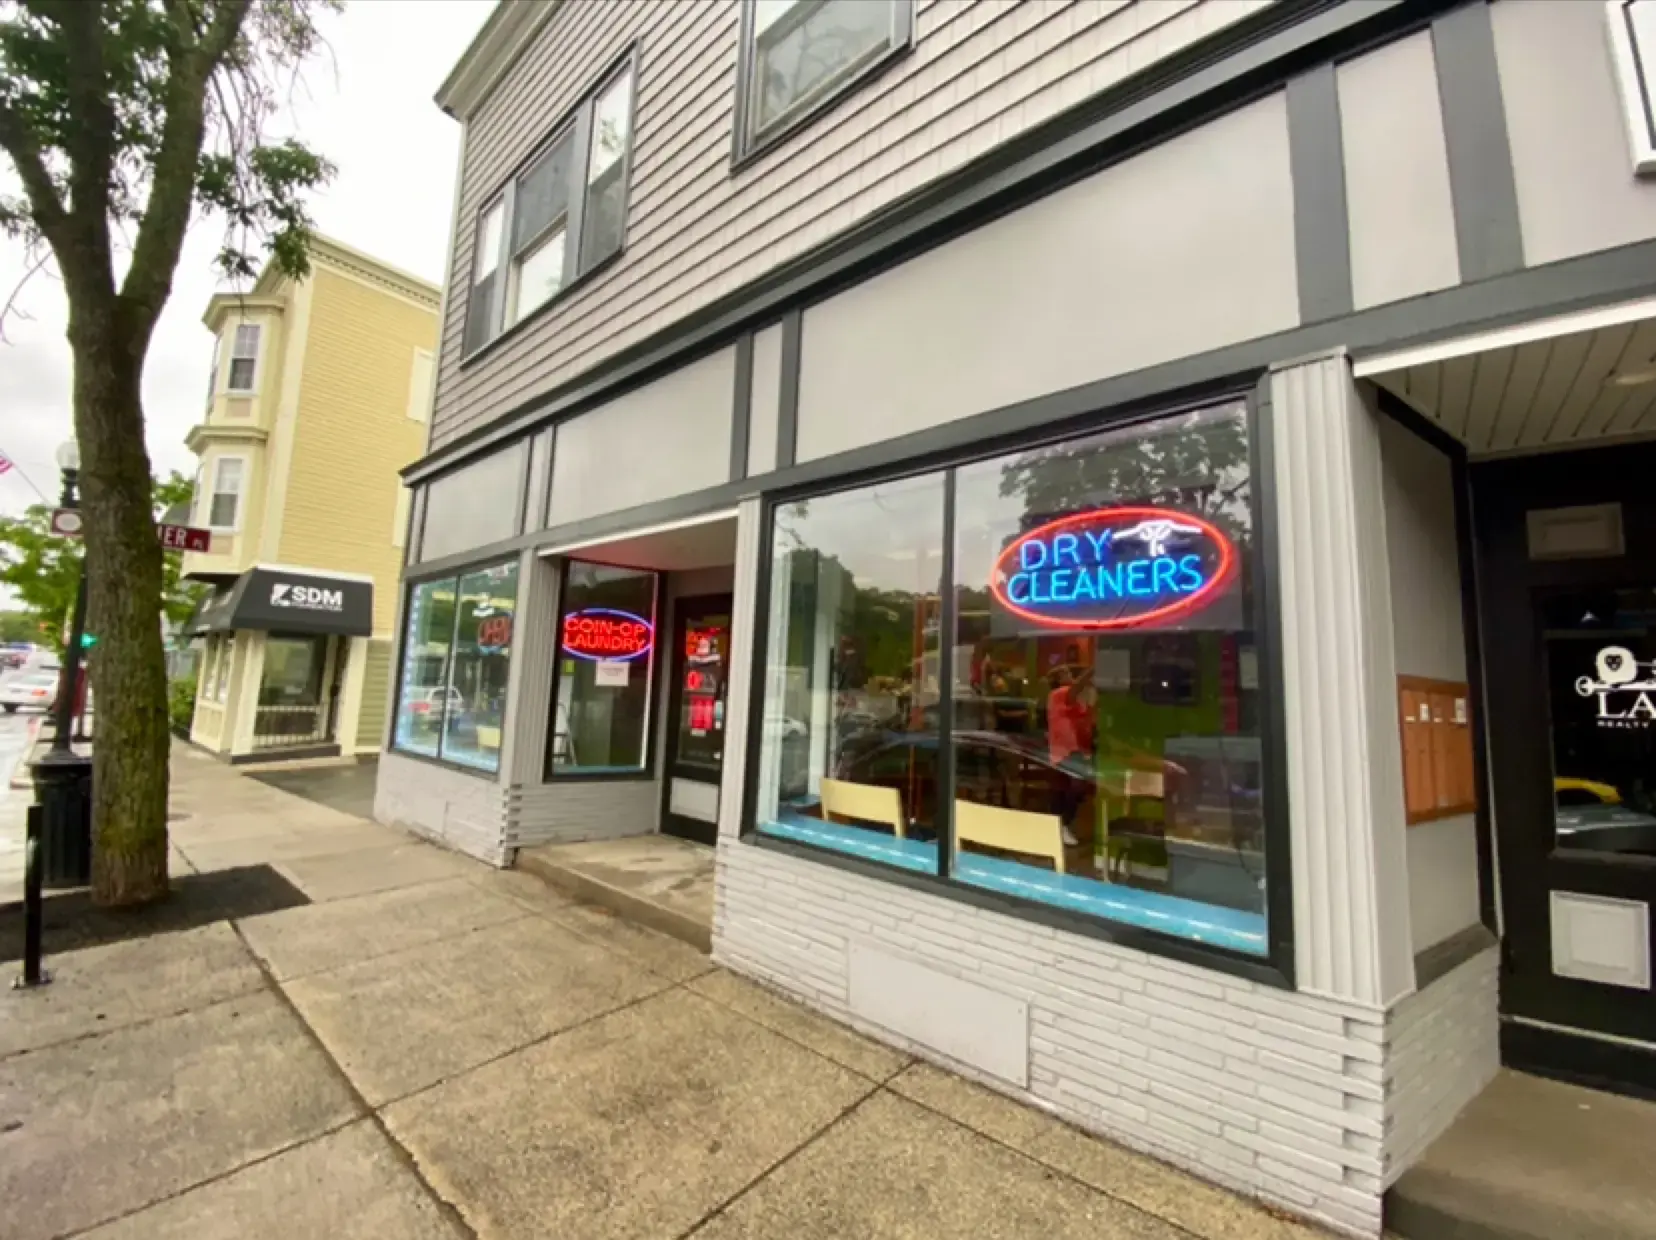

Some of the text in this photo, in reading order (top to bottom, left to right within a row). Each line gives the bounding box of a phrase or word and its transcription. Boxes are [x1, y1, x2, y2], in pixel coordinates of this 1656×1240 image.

[1020, 527, 1113, 571] DRY
[1007, 554, 1203, 605] CLEANERS
[291, 585, 343, 605] SDM
[564, 618, 646, 637] COIN-OP
[564, 632, 645, 651] LAUNDRY
